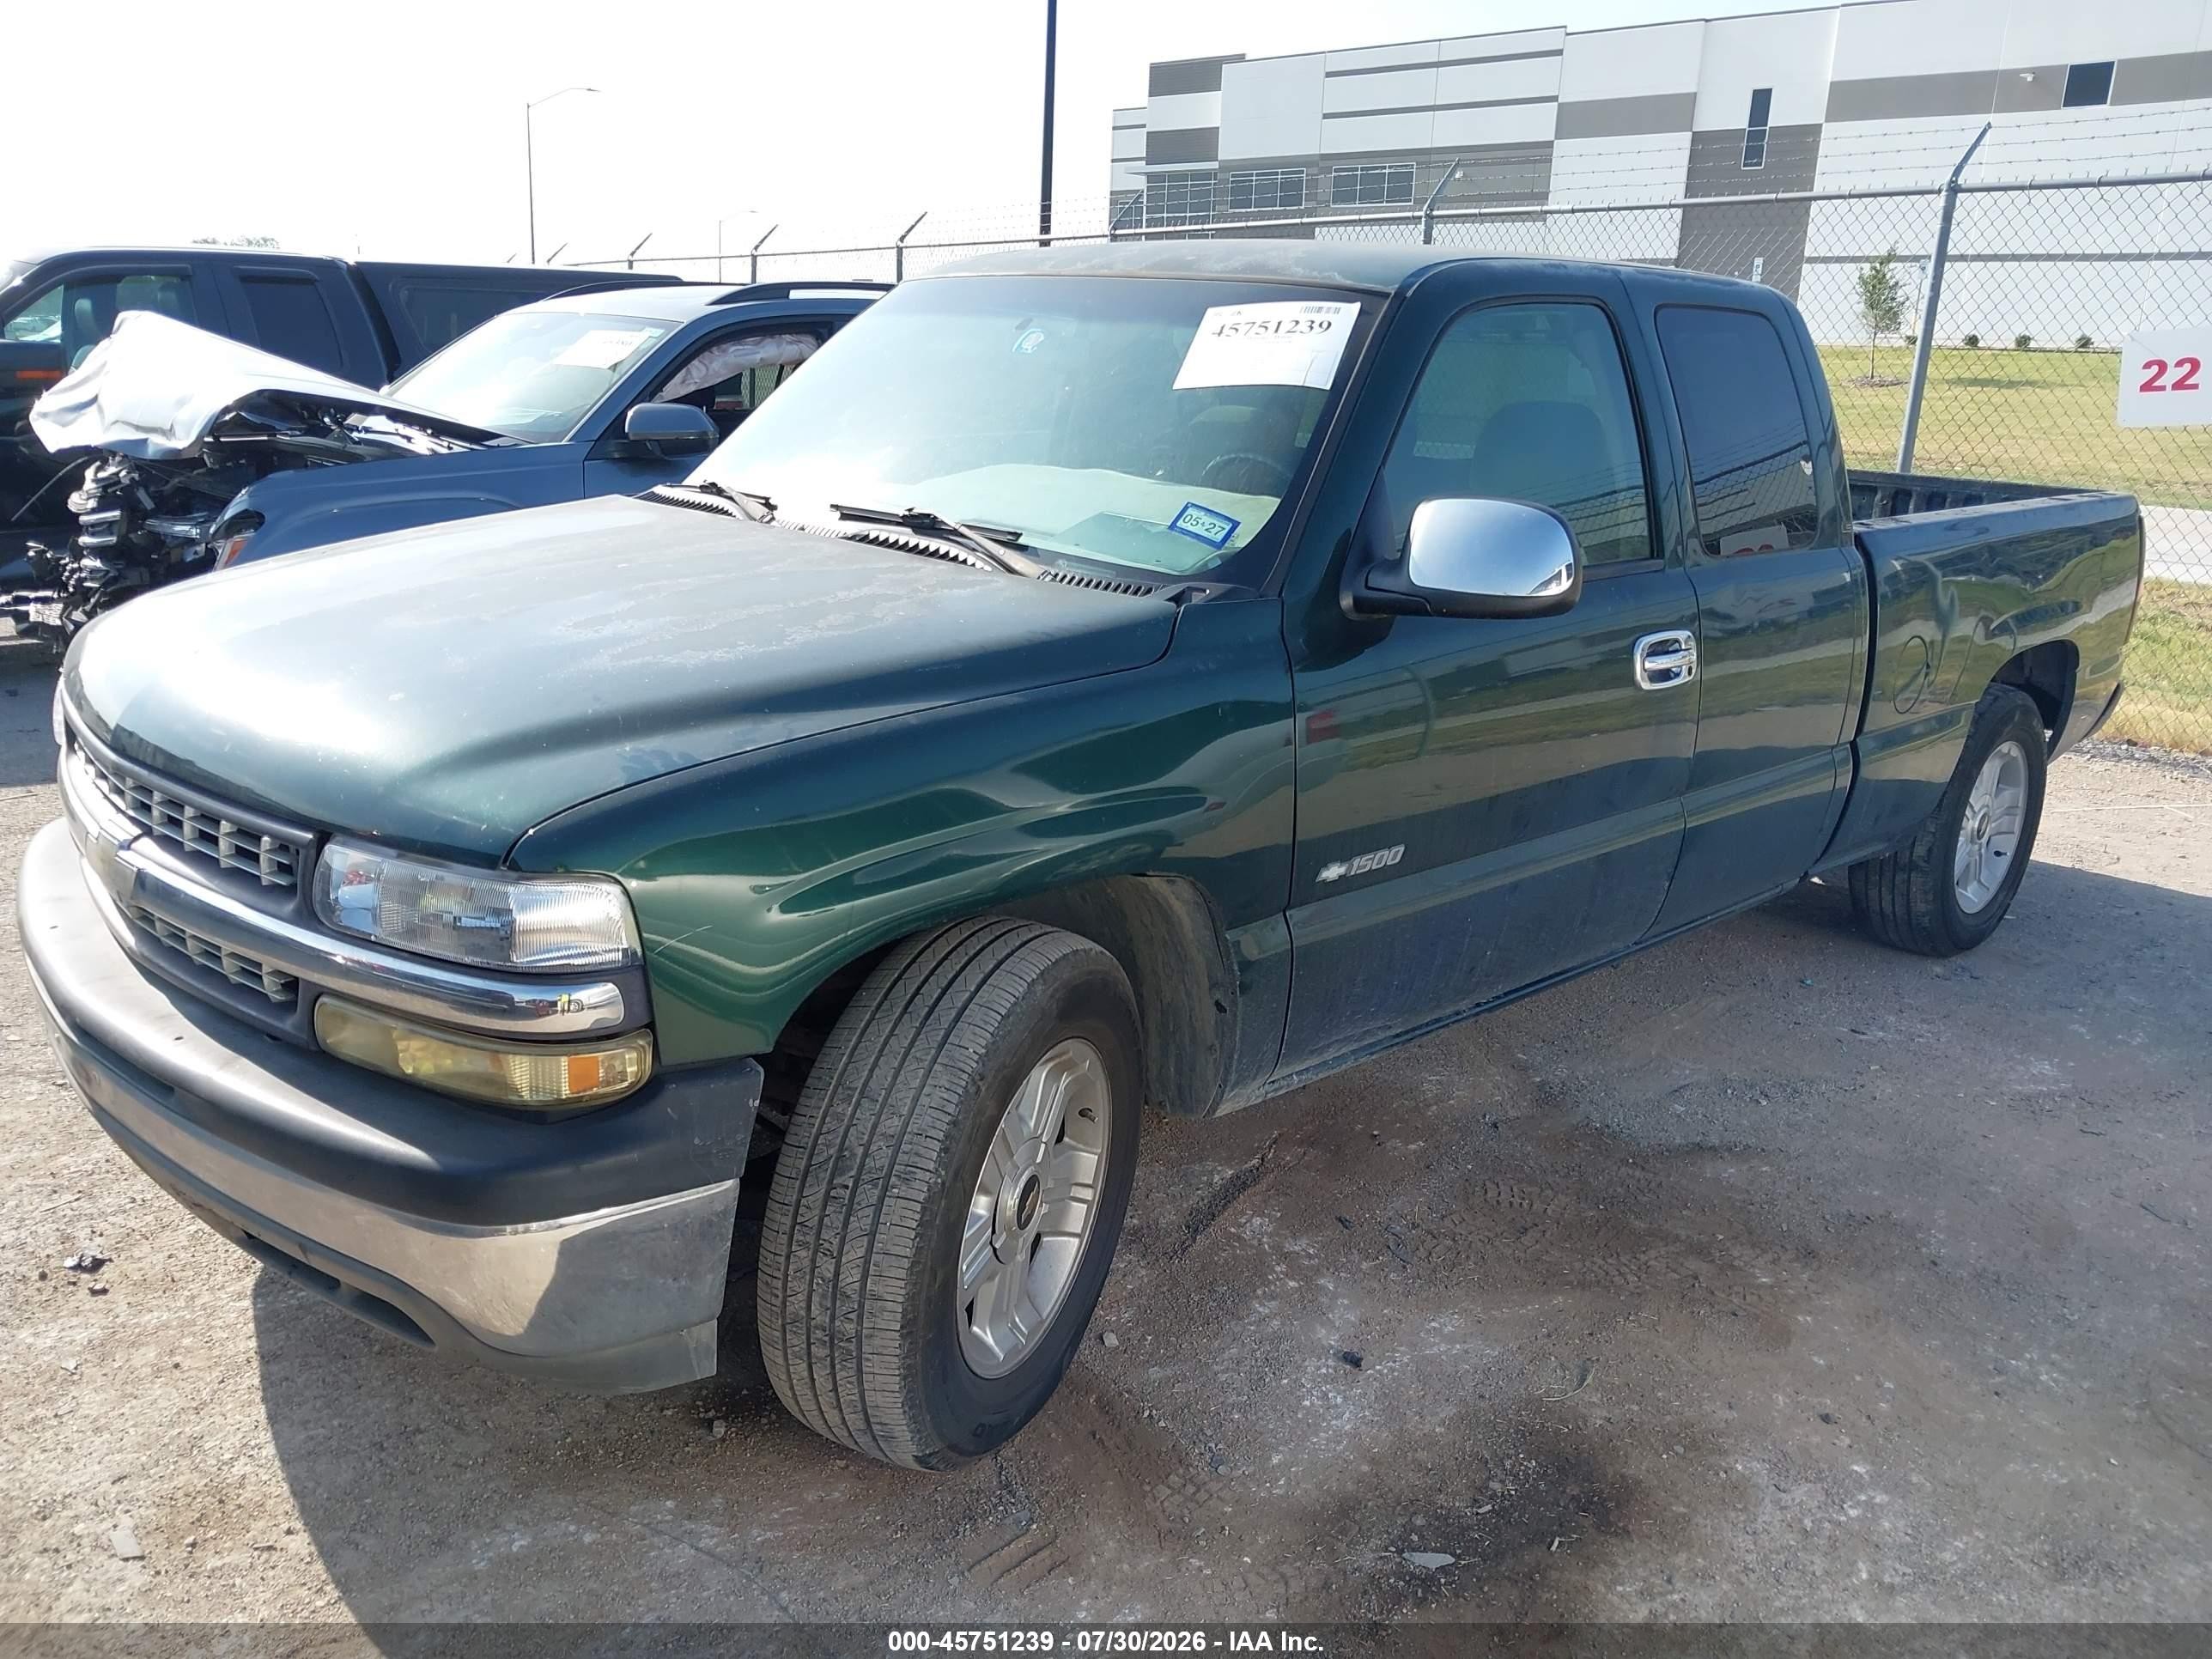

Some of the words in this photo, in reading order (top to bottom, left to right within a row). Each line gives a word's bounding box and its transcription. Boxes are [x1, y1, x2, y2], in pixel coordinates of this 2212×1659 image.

[1212, 319, 1333, 337] 45751239
[2139, 356, 2202, 392] 22
[1349, 843, 1406, 876] 1500
